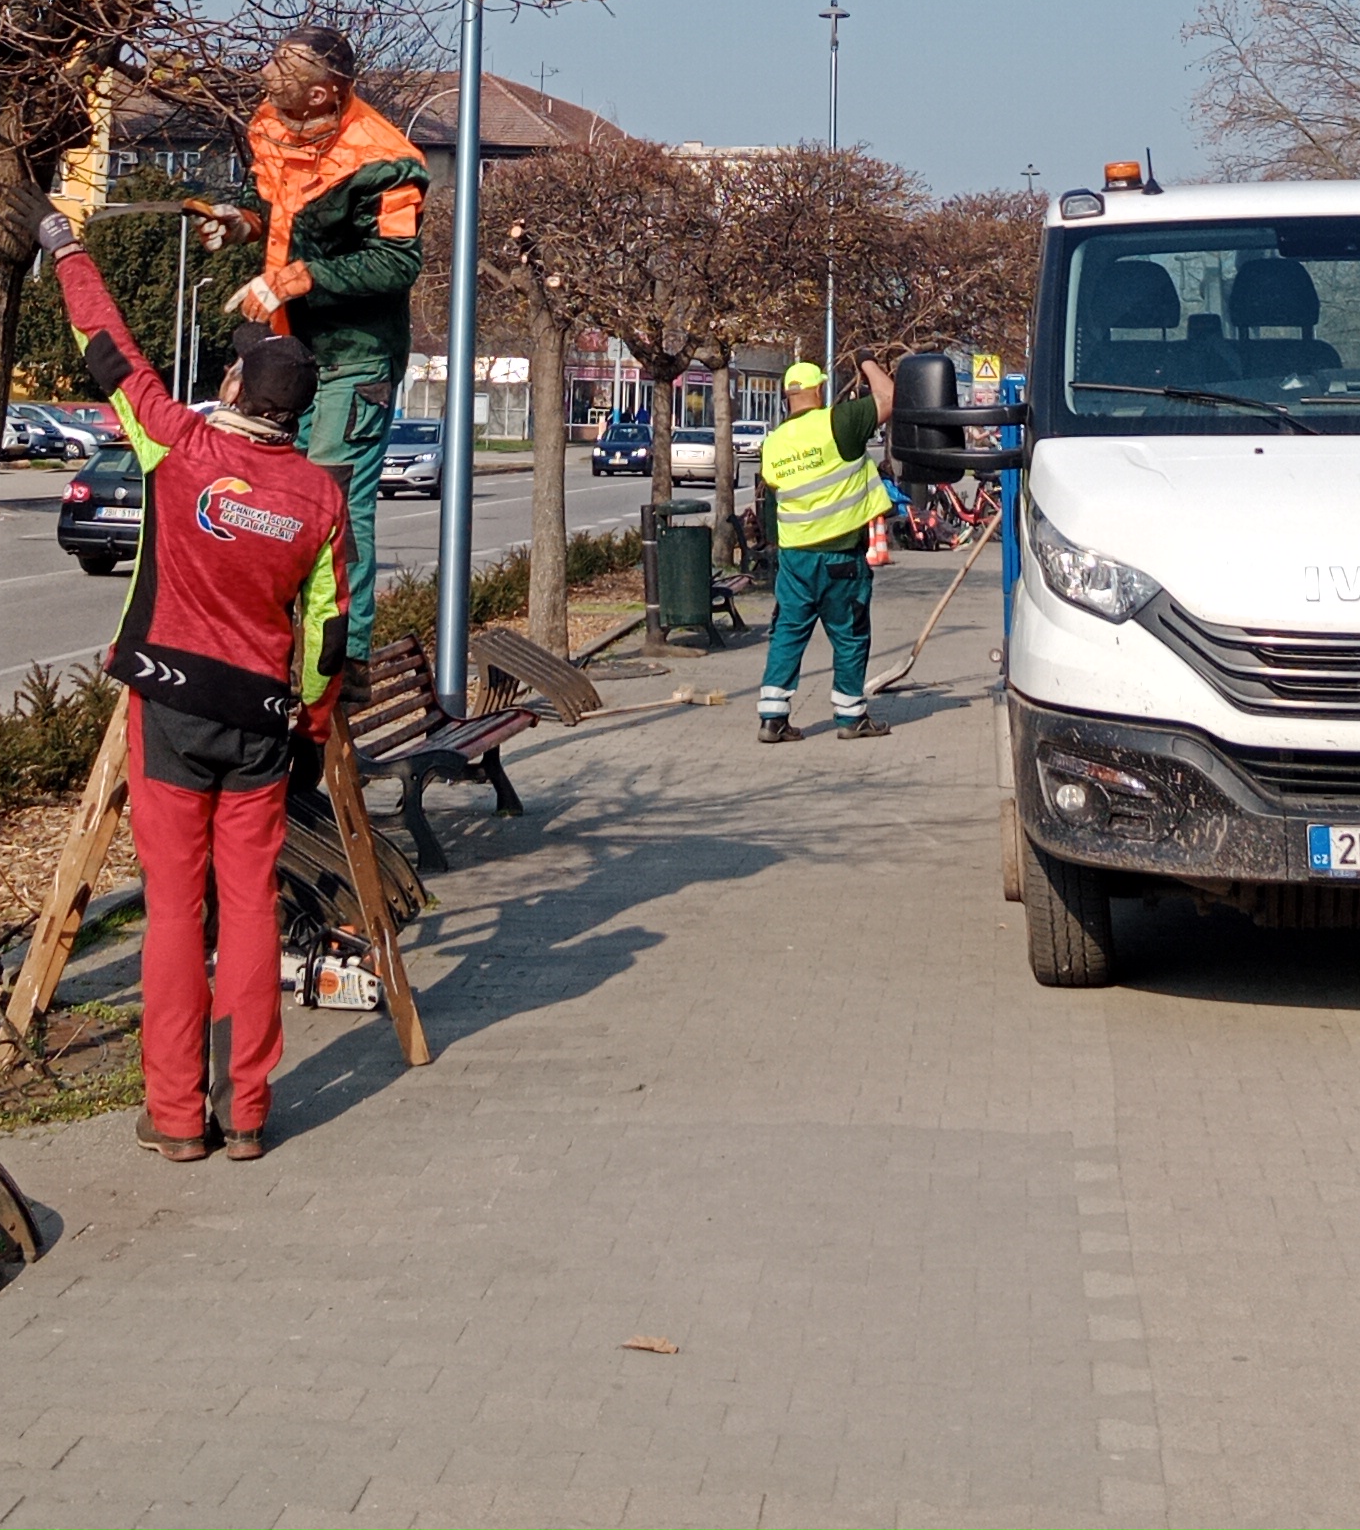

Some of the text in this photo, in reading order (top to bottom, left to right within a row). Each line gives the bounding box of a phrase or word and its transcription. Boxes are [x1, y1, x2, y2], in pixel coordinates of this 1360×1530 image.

[220, 497, 303, 532] TECHNICKÉ SLUŽBY
[220, 511, 251, 529] MĚSTA
[1313, 854, 1329, 865] CZ
